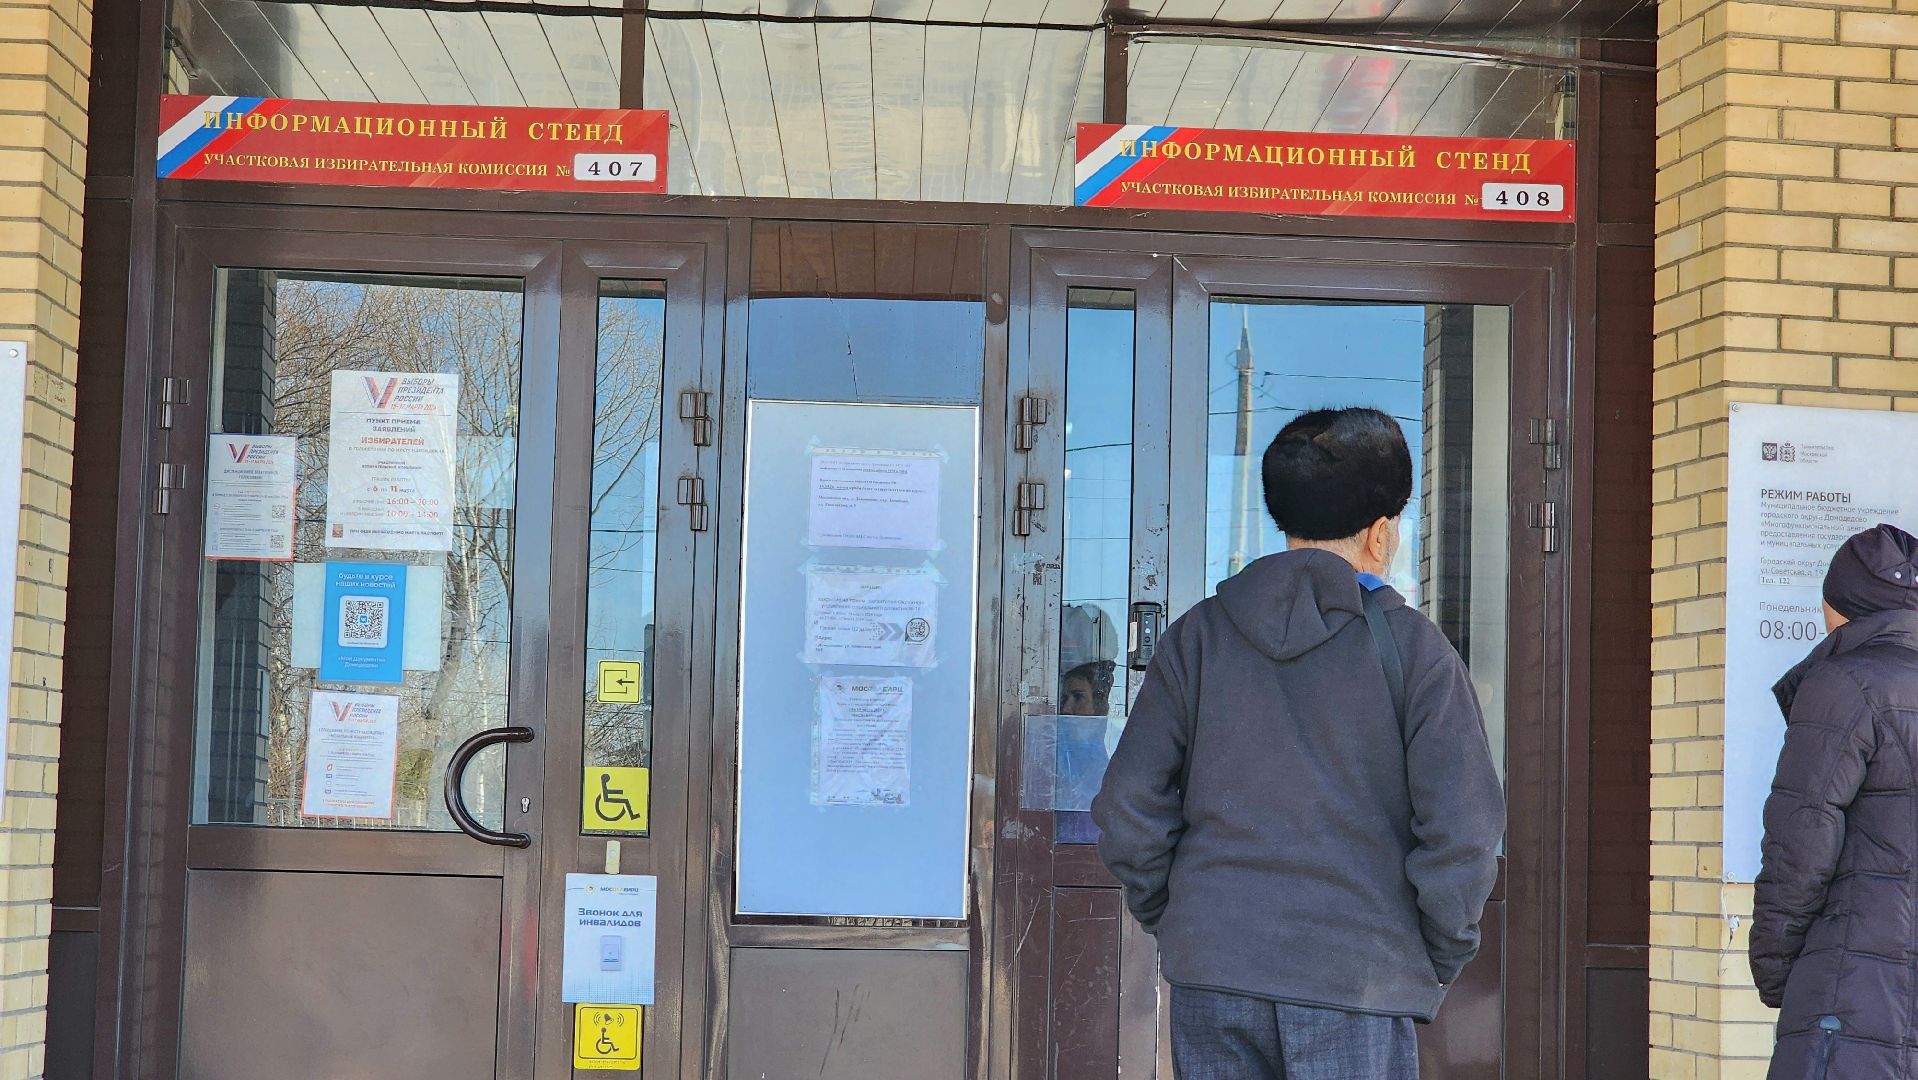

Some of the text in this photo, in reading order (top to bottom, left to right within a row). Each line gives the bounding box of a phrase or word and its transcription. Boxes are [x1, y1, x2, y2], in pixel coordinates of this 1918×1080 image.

[203, 110, 623, 144] ИНФОРМАЦИОННЫЙ СТЕНД
[1119, 139, 1531, 174] ИНФОРМАЦИОННЫЙ СТЕНД
[204, 153, 309, 168] УЧАСТКОВАЯ
[314, 157, 453, 174] ИЗБИРАТЕЛЬНАЯ
[458, 162, 548, 176] КОМИССИЯ
[556, 165, 570, 176] №
[1121, 181, 1224, 197] УЧАСТКОВАЯ
[1228, 186, 1363, 202] ИЗБИРАТЕЛЬНАЯ
[1368, 191, 1456, 205] КОМИССИЯ
[1464, 194, 1479, 206] №
[401, 377, 435, 386] ВЫБОРЫ
[397, 386, 445, 395] ПРЕЗИДЕНТА
[372, 425, 416, 433] ЗАЯВЛЕНИЙ
[361, 436, 425, 446] ИЗБИРАТЕЛЕЙ
[1761, 489, 1851, 503] РЕЖИМ РАБОТЫ
[1761, 501, 1815, 510] Муниципальное
[1817, 504, 1856, 512] бюджетное
[1760, 512, 1799, 520] городского
[1824, 514, 1867, 522] Домодедово
[1760, 557, 1796, 566] Городской
[1760, 601, 1822, 614] Понедельник
[578, 907, 643, 918] Звонок для
[579, 919, 641, 928] инвалидов
